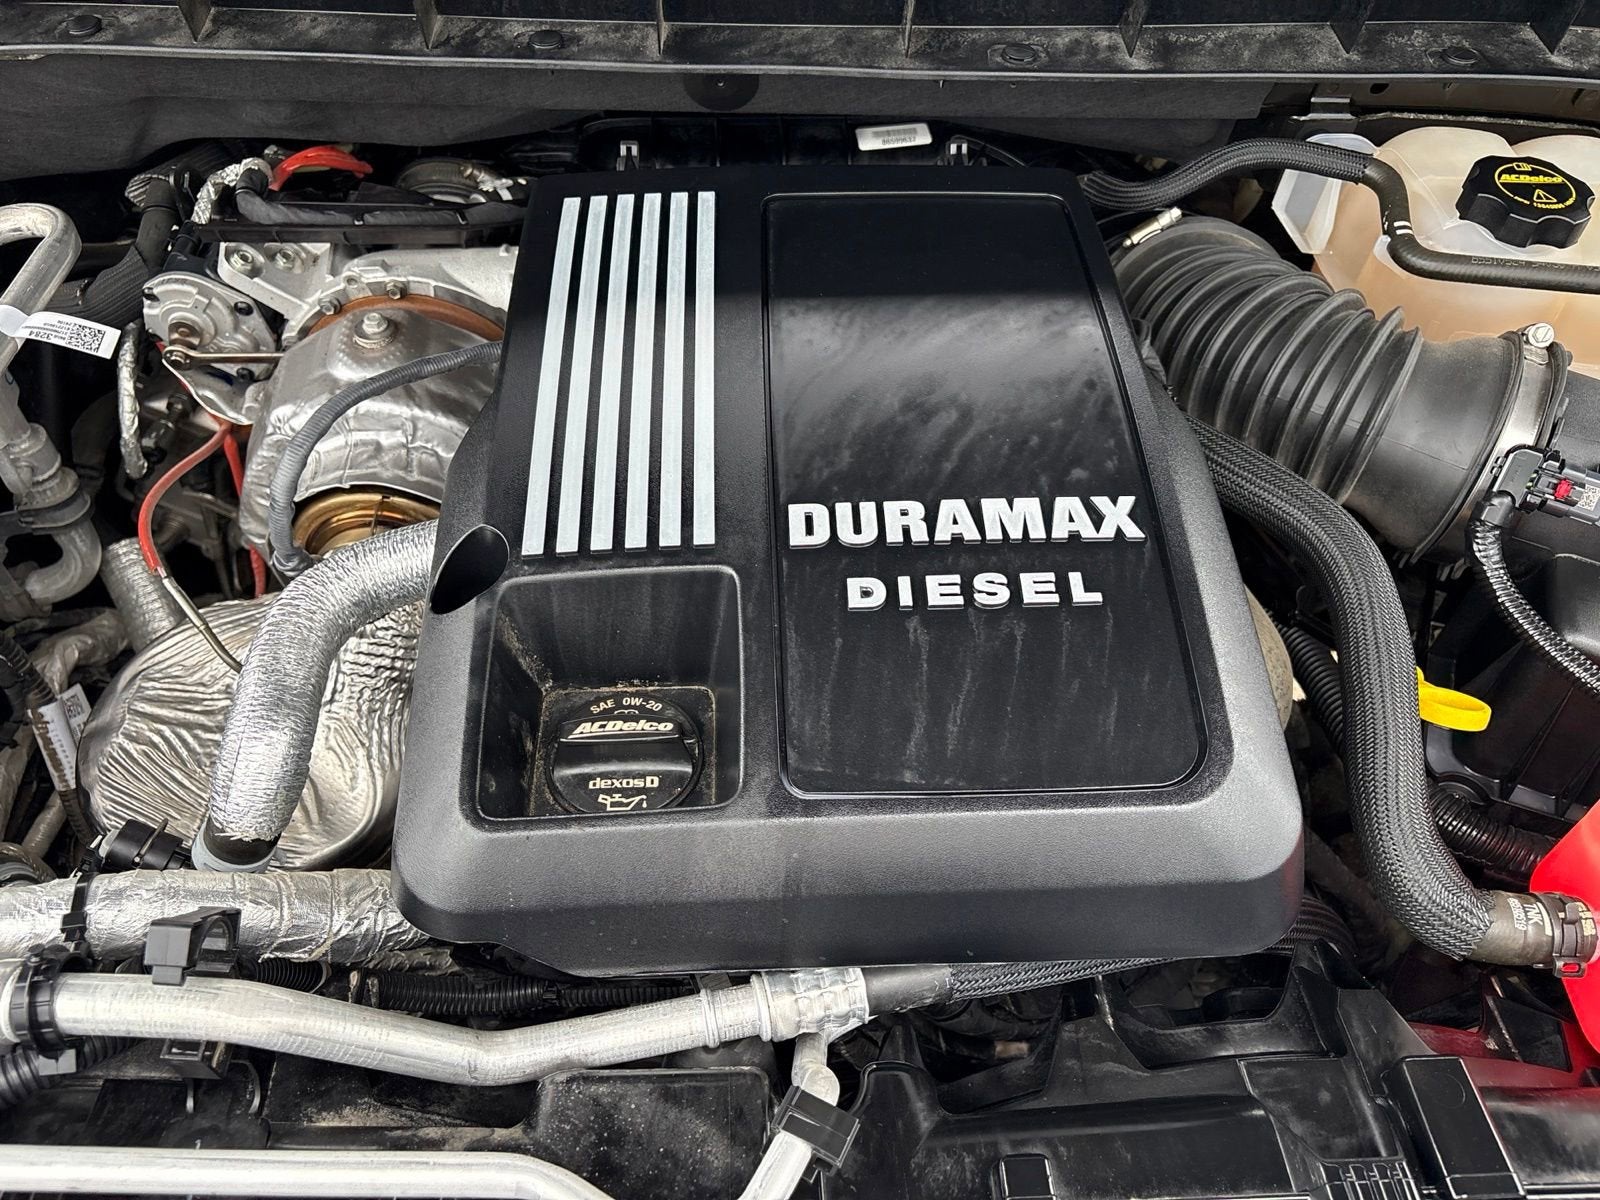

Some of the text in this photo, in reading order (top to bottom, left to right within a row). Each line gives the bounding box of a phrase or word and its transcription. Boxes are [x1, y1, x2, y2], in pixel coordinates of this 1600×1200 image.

[1500, 173, 1564, 184] ACDelco
[28, 330, 53, 341] 3284
[788, 496, 1145, 548] DURAMAX
[846, 571, 1103, 612] DIESEL
[590, 697, 663, 714] SAE 0W-20
[571, 719, 674, 735] ACDelco
[588, 775, 660, 790] dexosD
[1523, 903, 1543, 926] TNK
